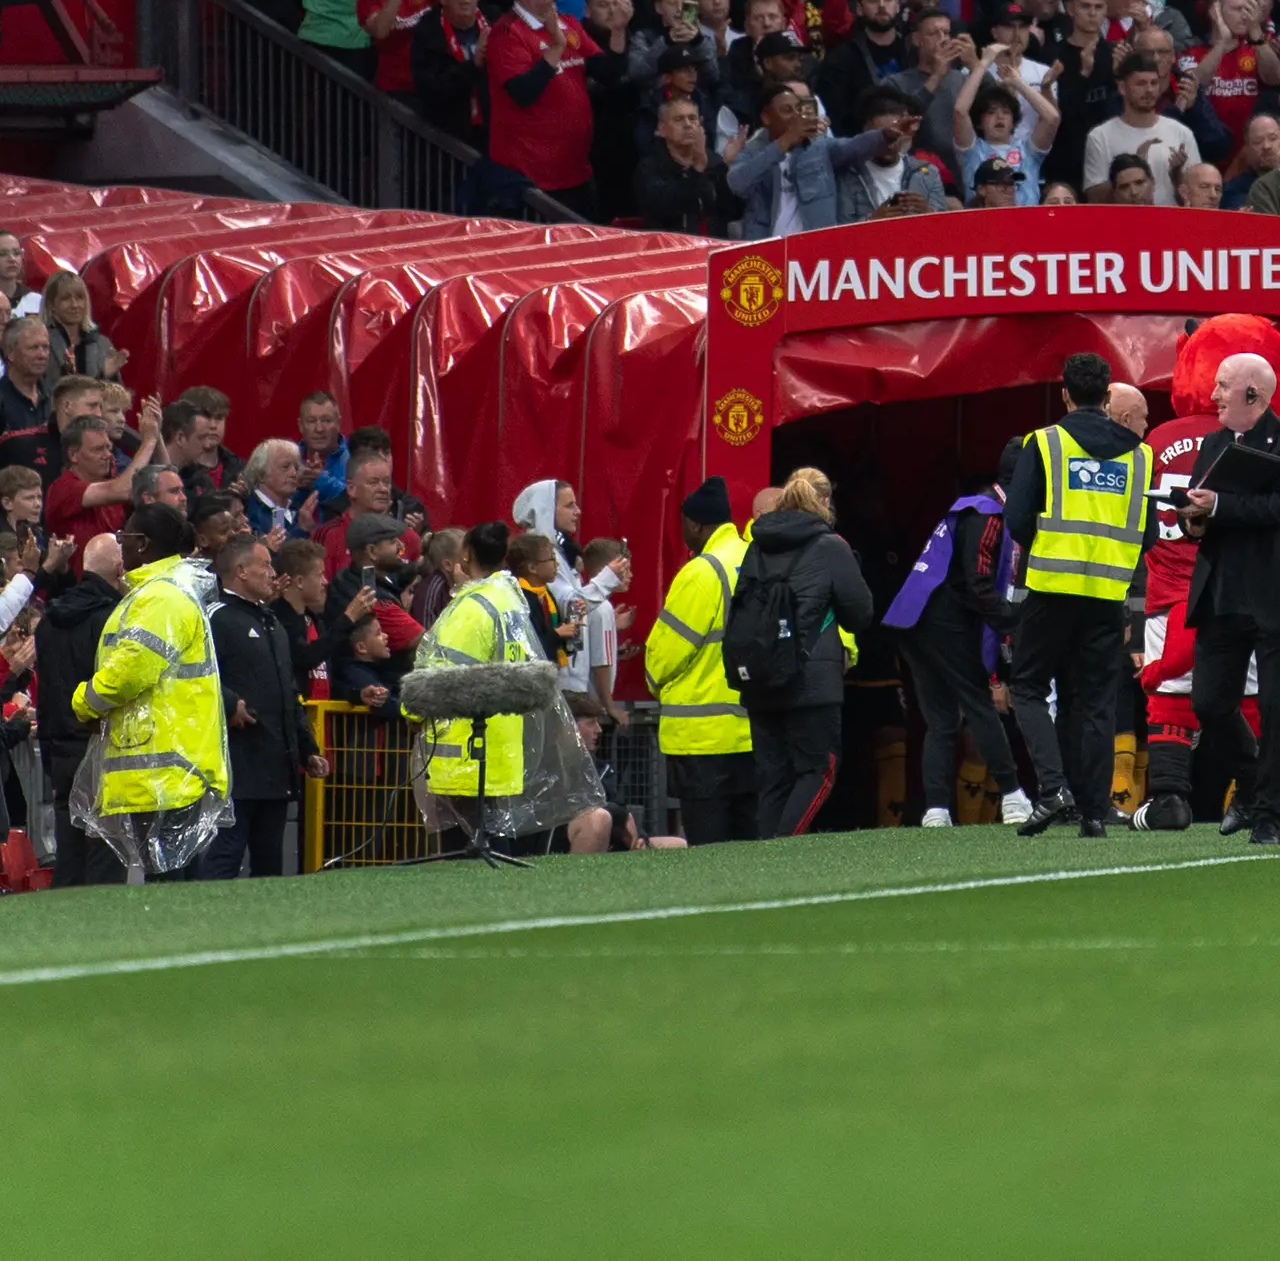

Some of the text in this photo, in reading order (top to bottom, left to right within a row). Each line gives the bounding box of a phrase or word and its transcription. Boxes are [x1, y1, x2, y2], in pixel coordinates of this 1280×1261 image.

[787, 251, 1127, 303] MANCHESTER
[1161, 438, 1194, 466] FRED
[1094, 472, 1126, 488] CSG
